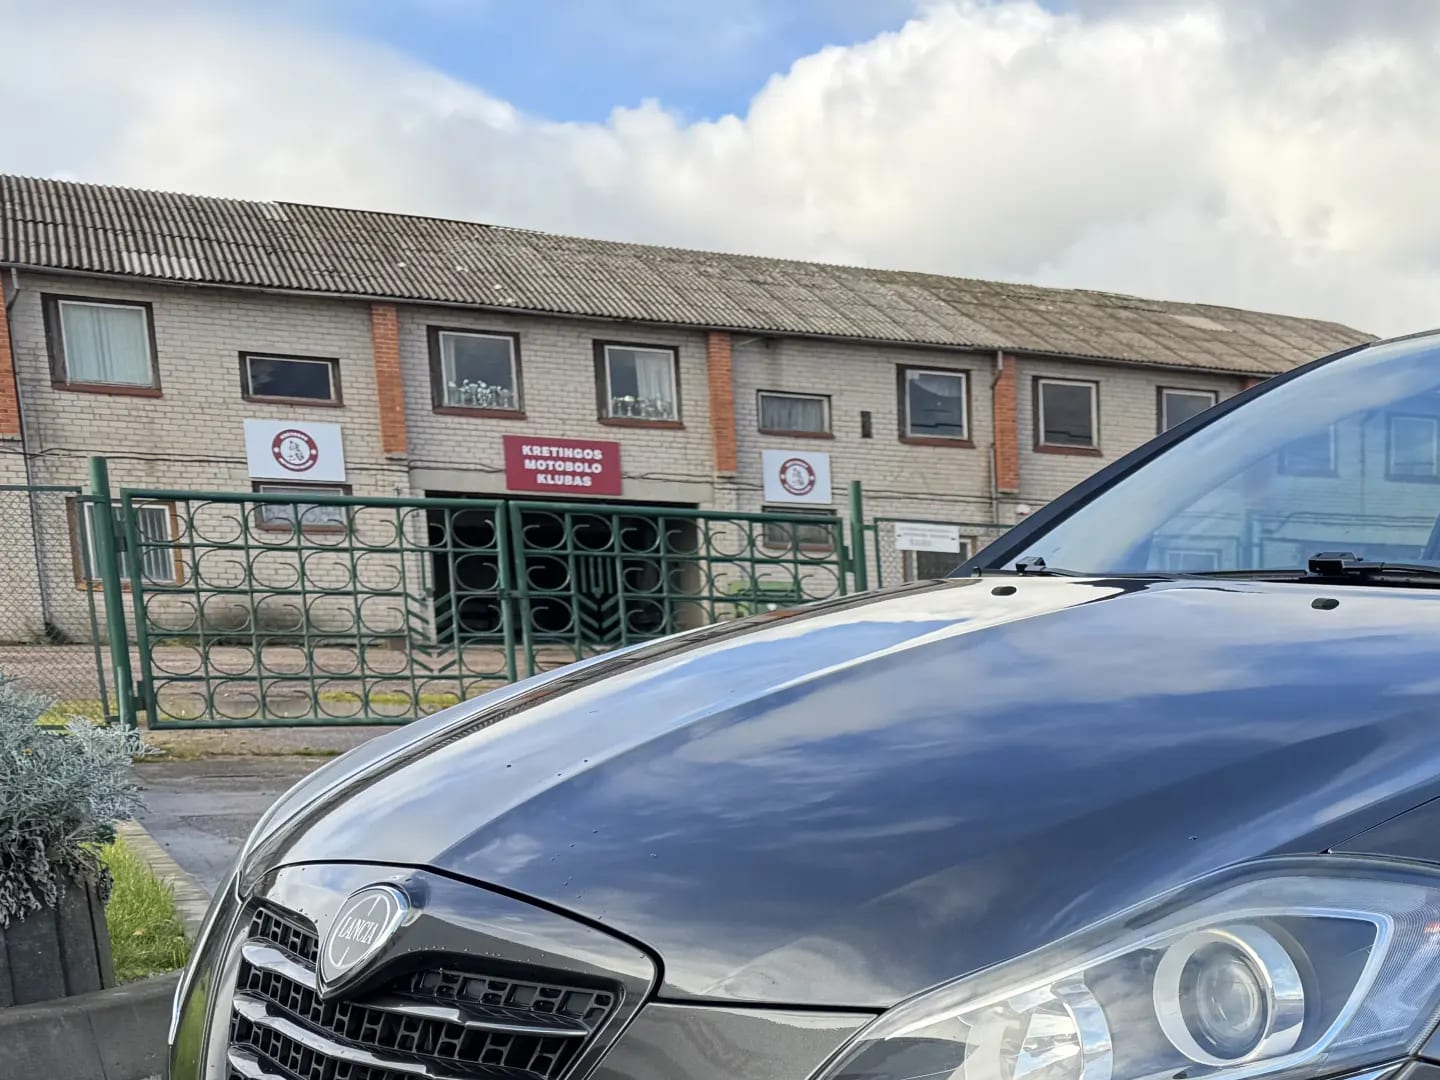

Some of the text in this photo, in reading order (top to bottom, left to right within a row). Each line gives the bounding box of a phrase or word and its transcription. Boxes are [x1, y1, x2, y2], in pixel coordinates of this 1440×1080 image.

[522, 445, 602, 460] KRETINGOS
[524, 459, 602, 474] MOTOBOLO
[536, 473, 592, 487] KLUBAS
[338, 917, 379, 944] LANCIA
